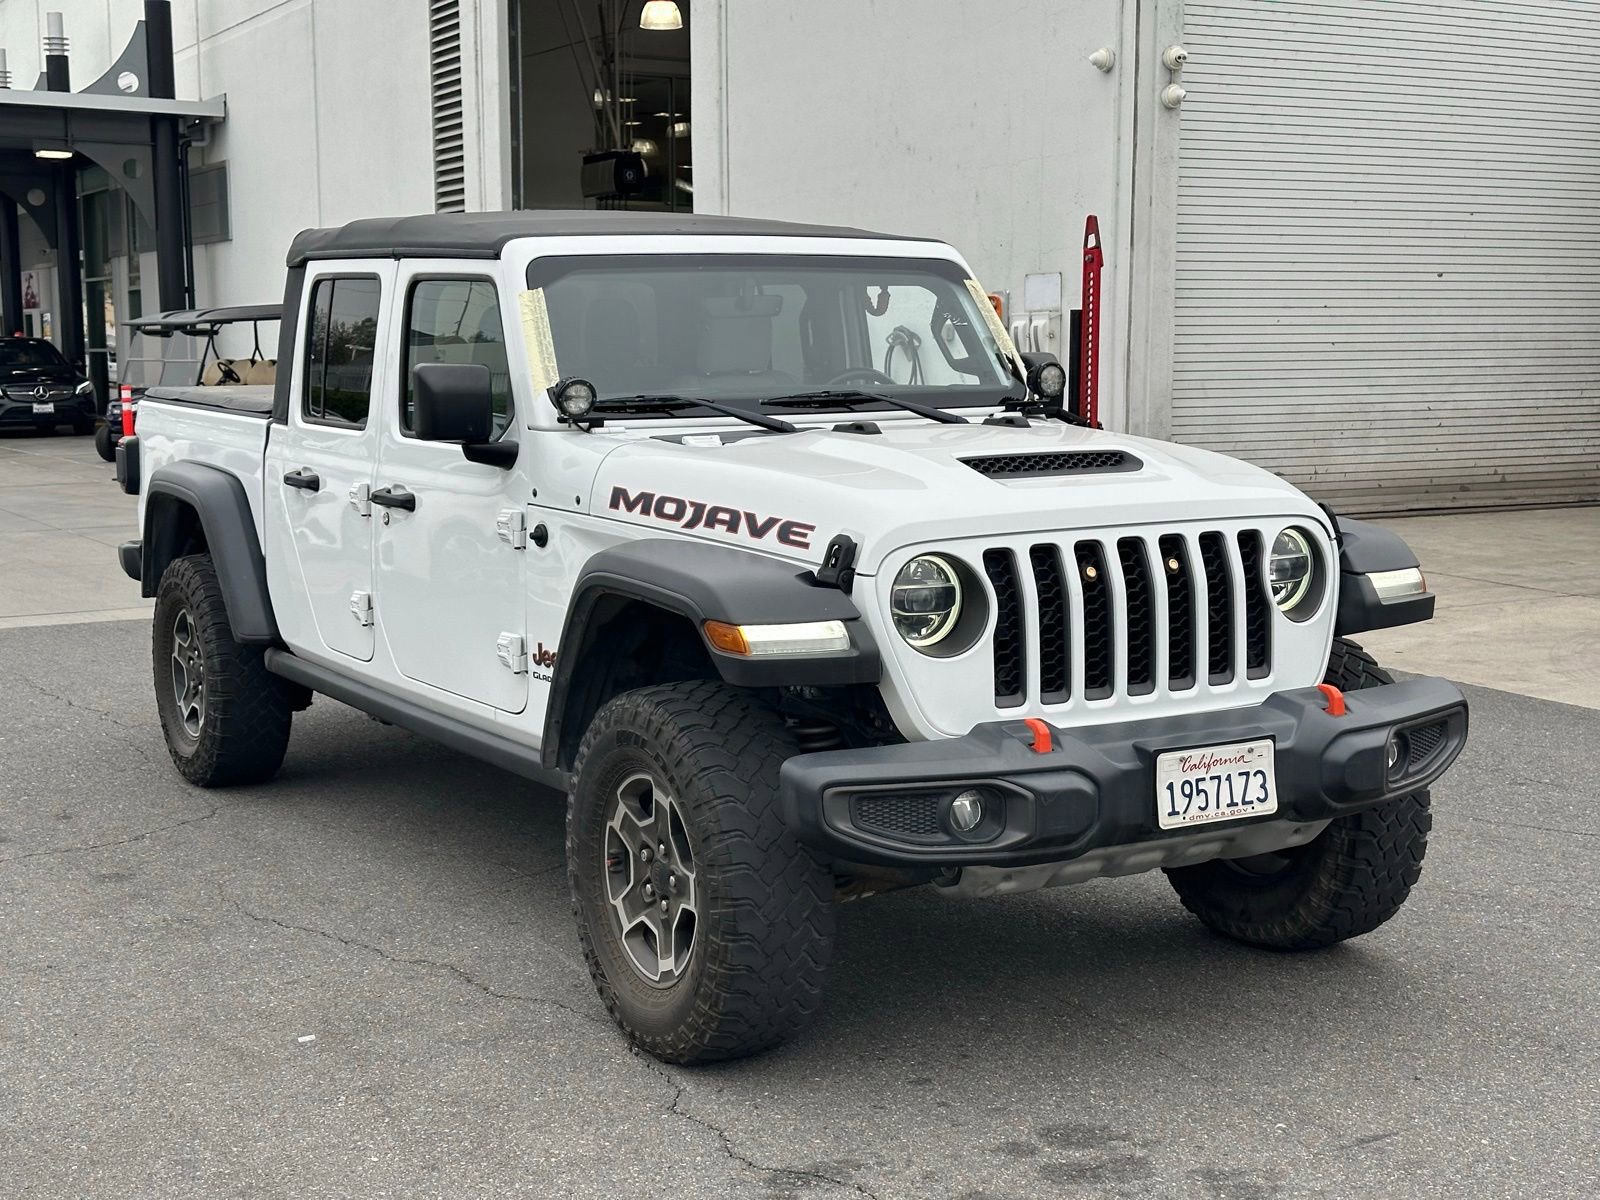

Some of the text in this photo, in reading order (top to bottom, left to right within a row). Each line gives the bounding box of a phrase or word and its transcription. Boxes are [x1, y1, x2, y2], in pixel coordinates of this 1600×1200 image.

[609, 486, 817, 550] MOJAVE
[1181, 752, 1252, 775] California
[1166, 769, 1269, 817] 19571Z3
[1188, 807, 1249, 821] dmv.ca.gov
